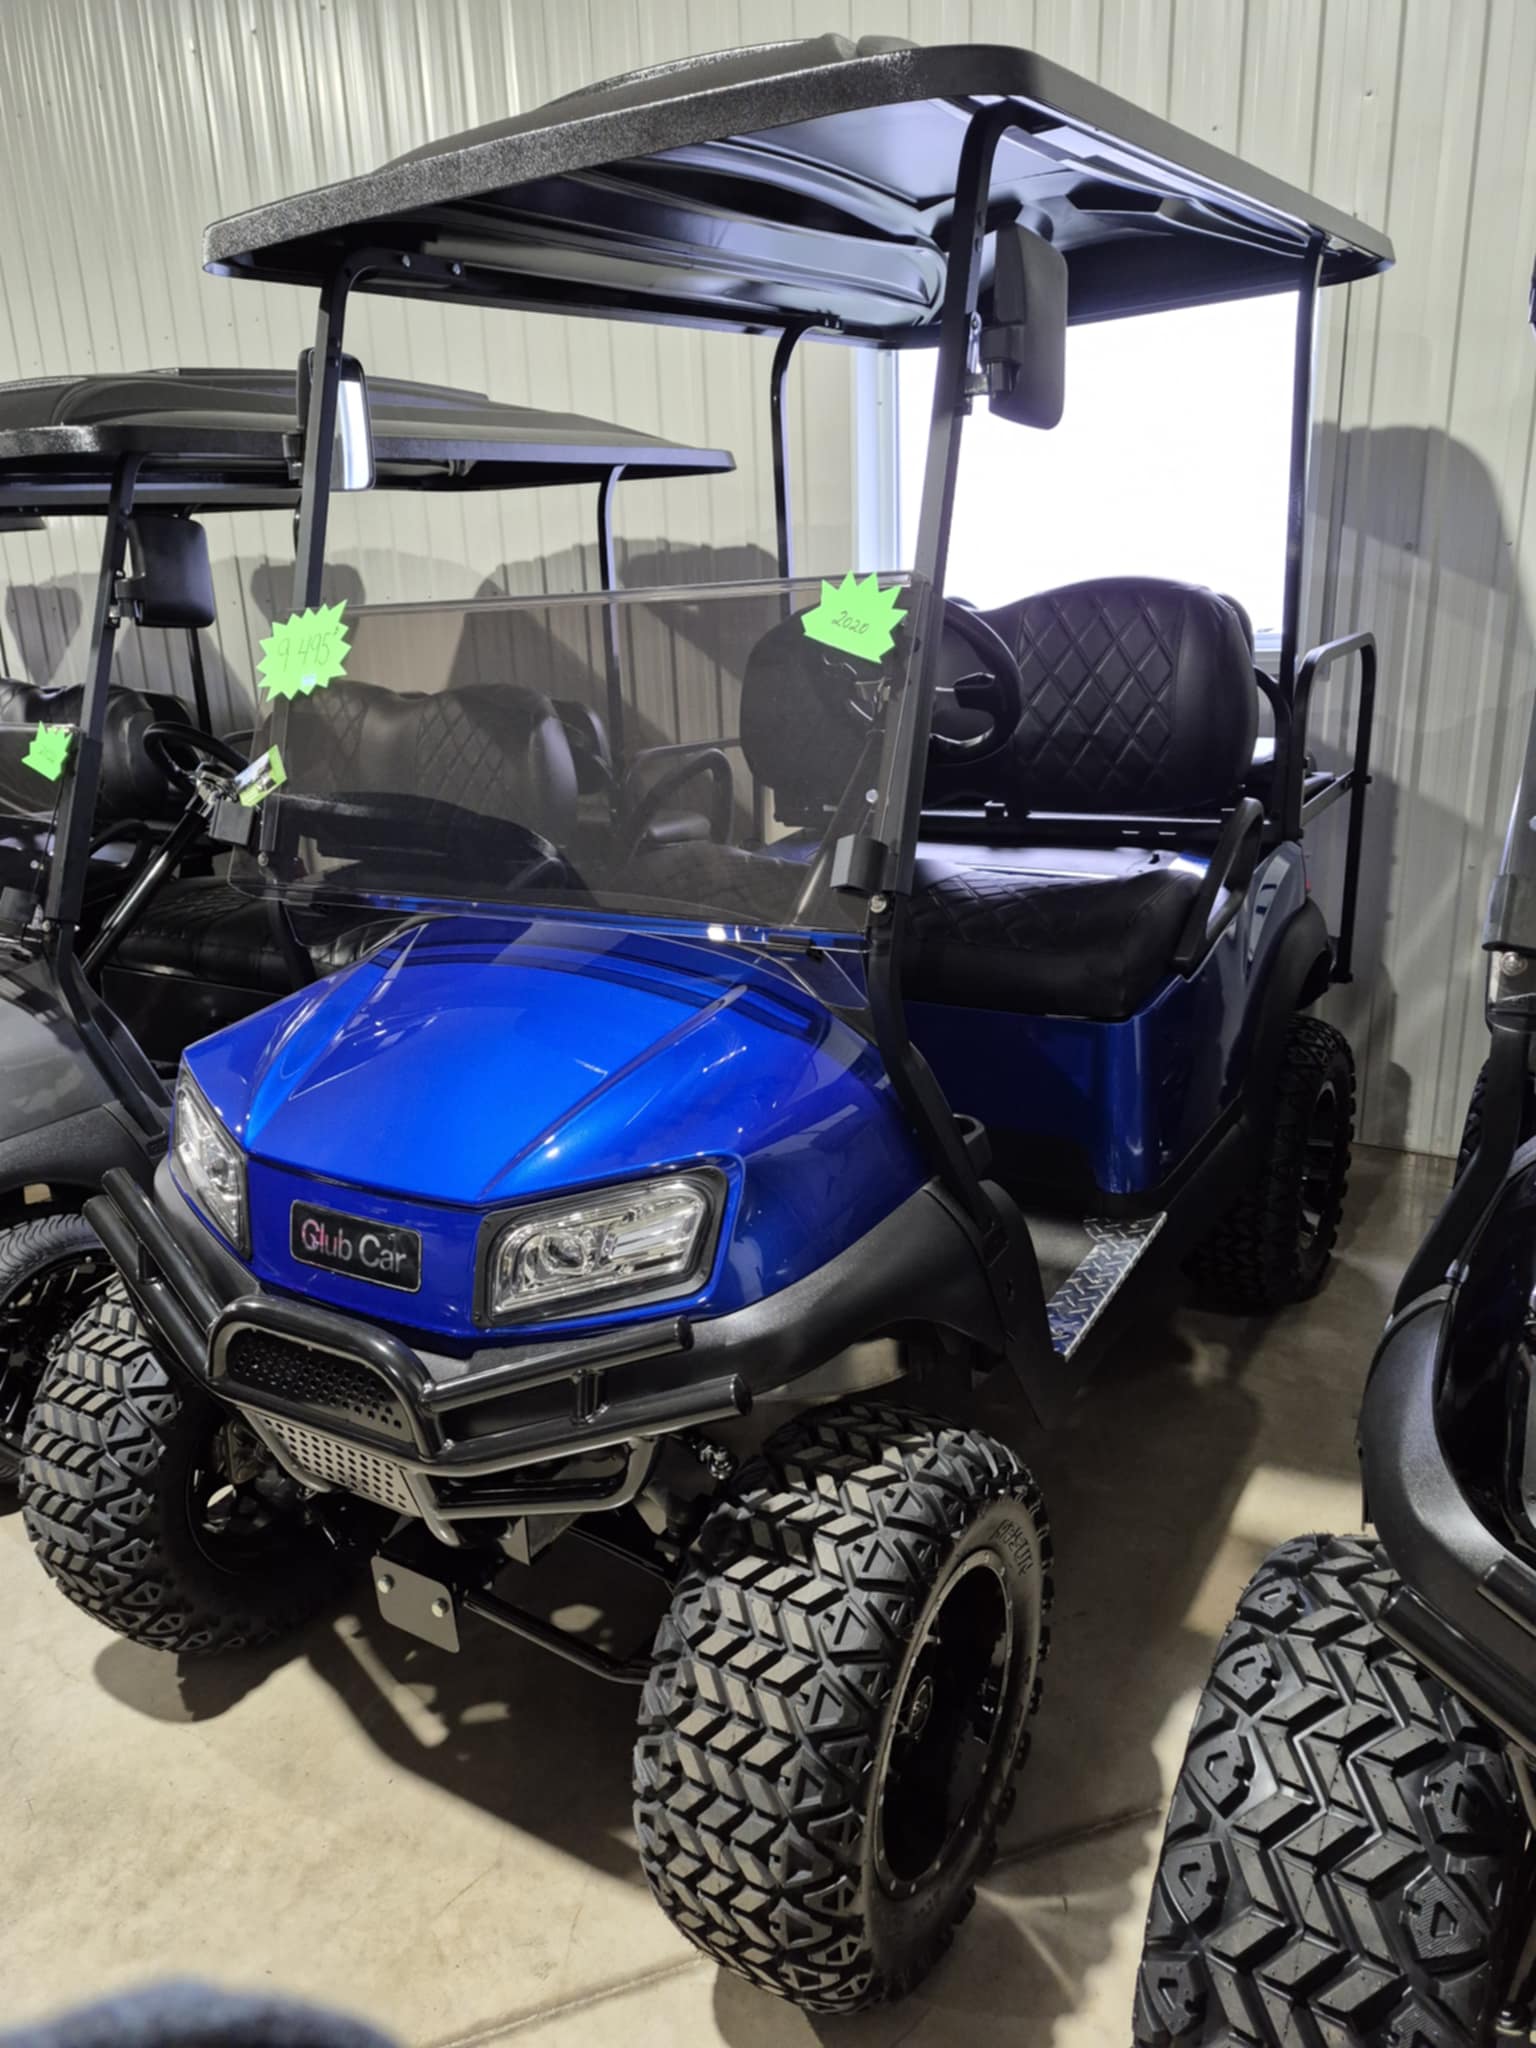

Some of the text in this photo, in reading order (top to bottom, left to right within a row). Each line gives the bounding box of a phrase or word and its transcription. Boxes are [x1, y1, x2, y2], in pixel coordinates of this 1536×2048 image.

[831, 609, 870, 635] 2020
[301, 1218, 407, 1273] Club Car
